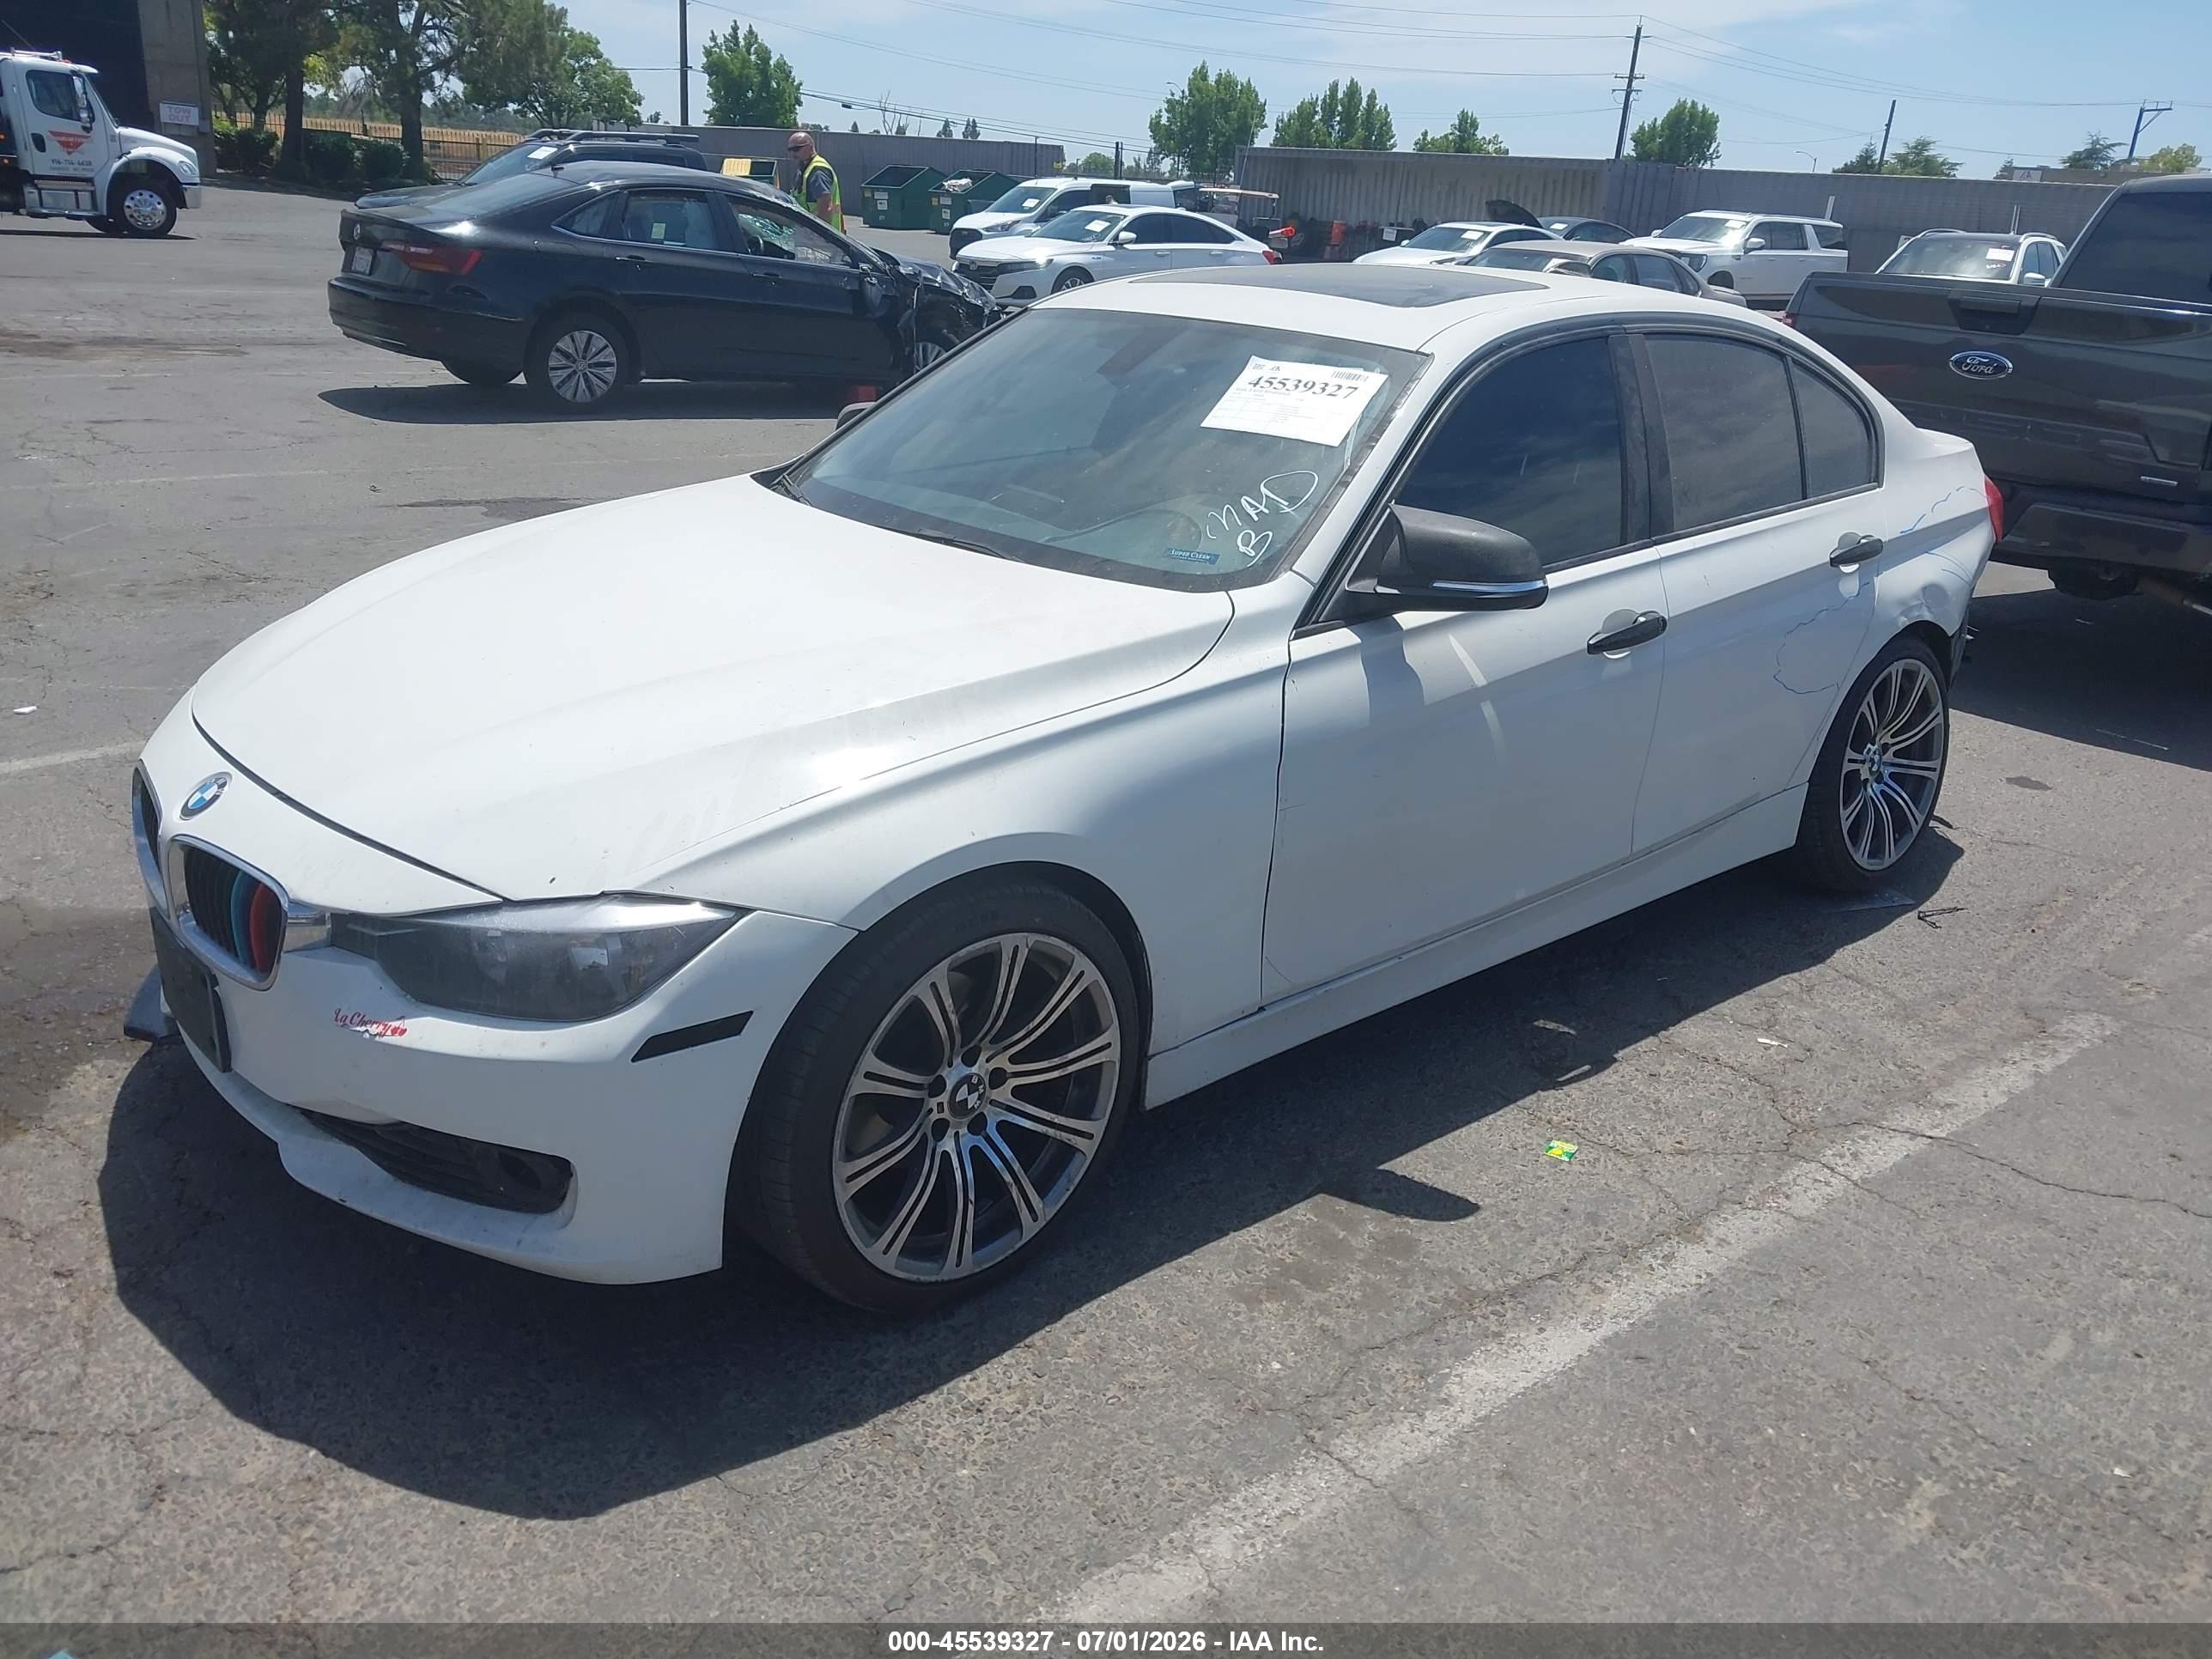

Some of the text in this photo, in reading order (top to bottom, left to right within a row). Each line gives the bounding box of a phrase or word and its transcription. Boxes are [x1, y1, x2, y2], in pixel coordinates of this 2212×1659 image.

[167, 106, 191, 114] TOW
[168, 113, 192, 124] OUT
[1962, 356, 1996, 374] Ford
[1248, 375, 1358, 399] 45539327
[349, 1012, 392, 1037] Cherry
